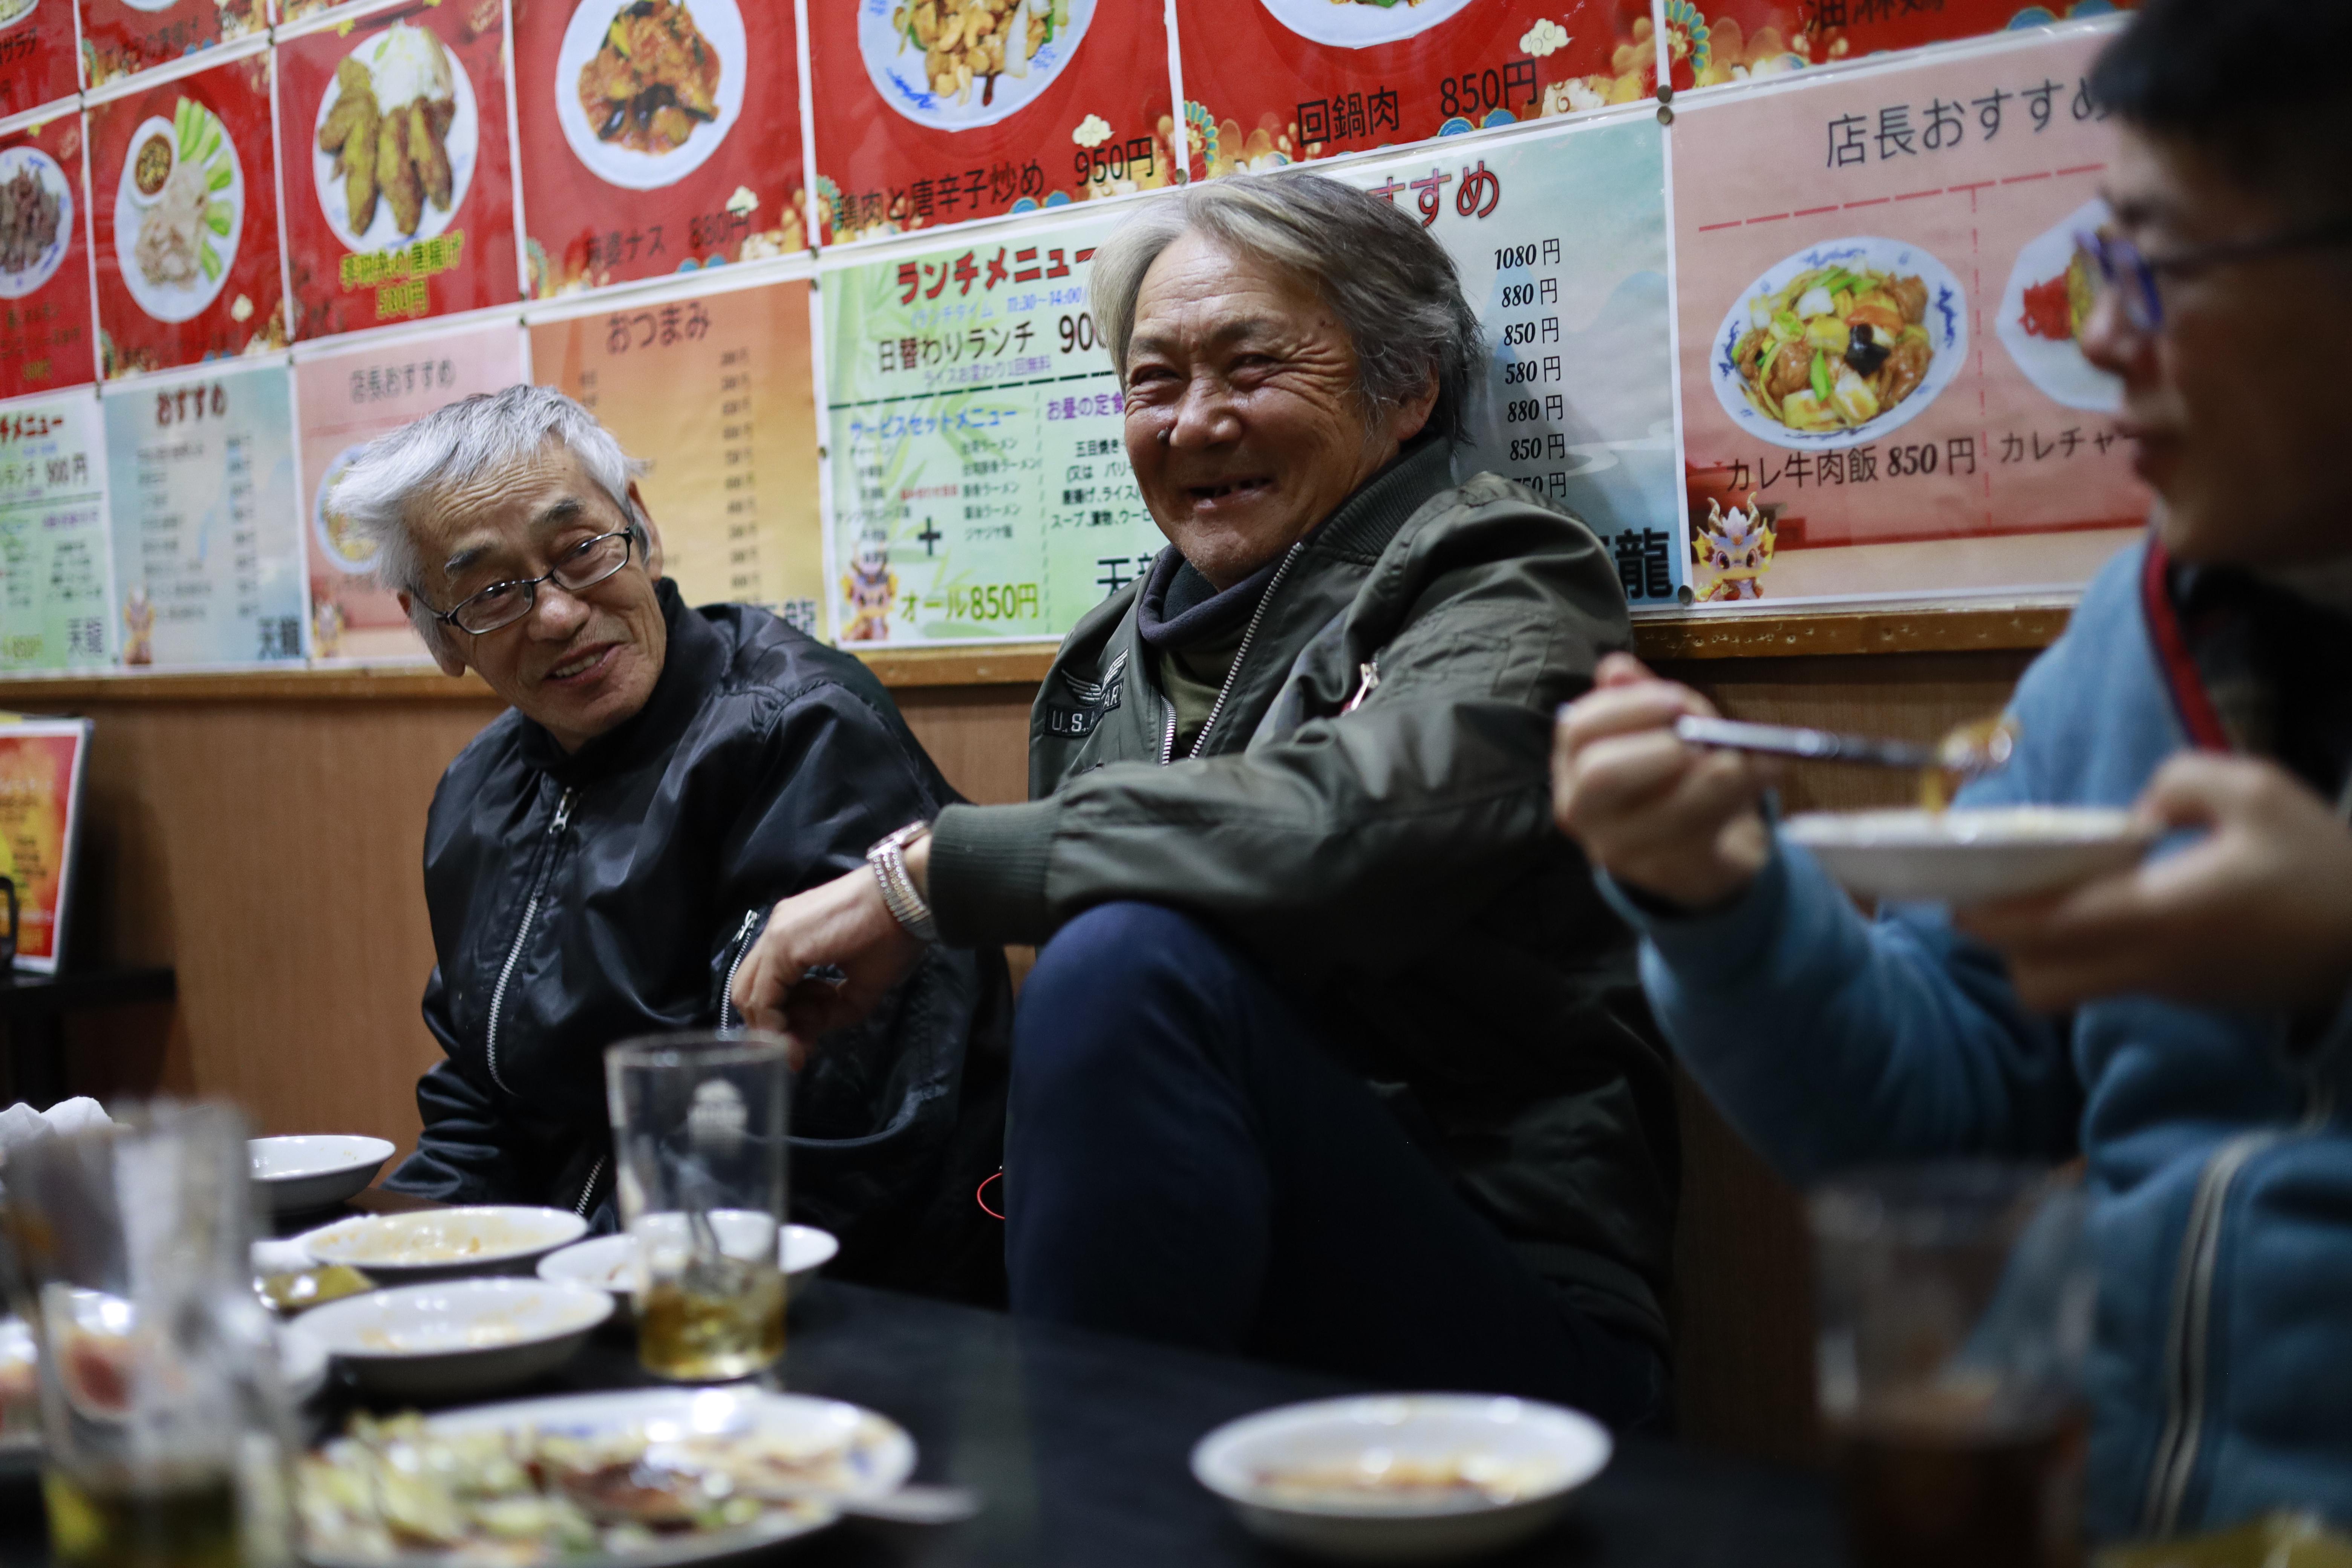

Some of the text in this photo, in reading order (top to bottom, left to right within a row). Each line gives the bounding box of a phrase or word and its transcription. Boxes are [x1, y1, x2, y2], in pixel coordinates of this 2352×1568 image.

[1297, 58, 1538, 148] 回鍋肉 850円
[1074, 136, 1154, 186] 950円
[898, 246, 1098, 305] ランチメニュー
[1494, 243, 1537, 270] 1080
[1501, 283, 1534, 308] 880
[606, 303, 711, 354] おつまみ
[880, 311, 1107, 374] 日替わりランチ 90
[1504, 321, 1536, 346] 850
[1505, 360, 1538, 385] 580
[1507, 399, 1540, 423] 880
[1509, 437, 1542, 461] 850
[1726, 444, 1878, 493] カレ牛肉飯
[1887, 443, 1939, 479] 850
[1599, 528, 1674, 599] 龍
[901, 583, 1038, 623] オール850円
